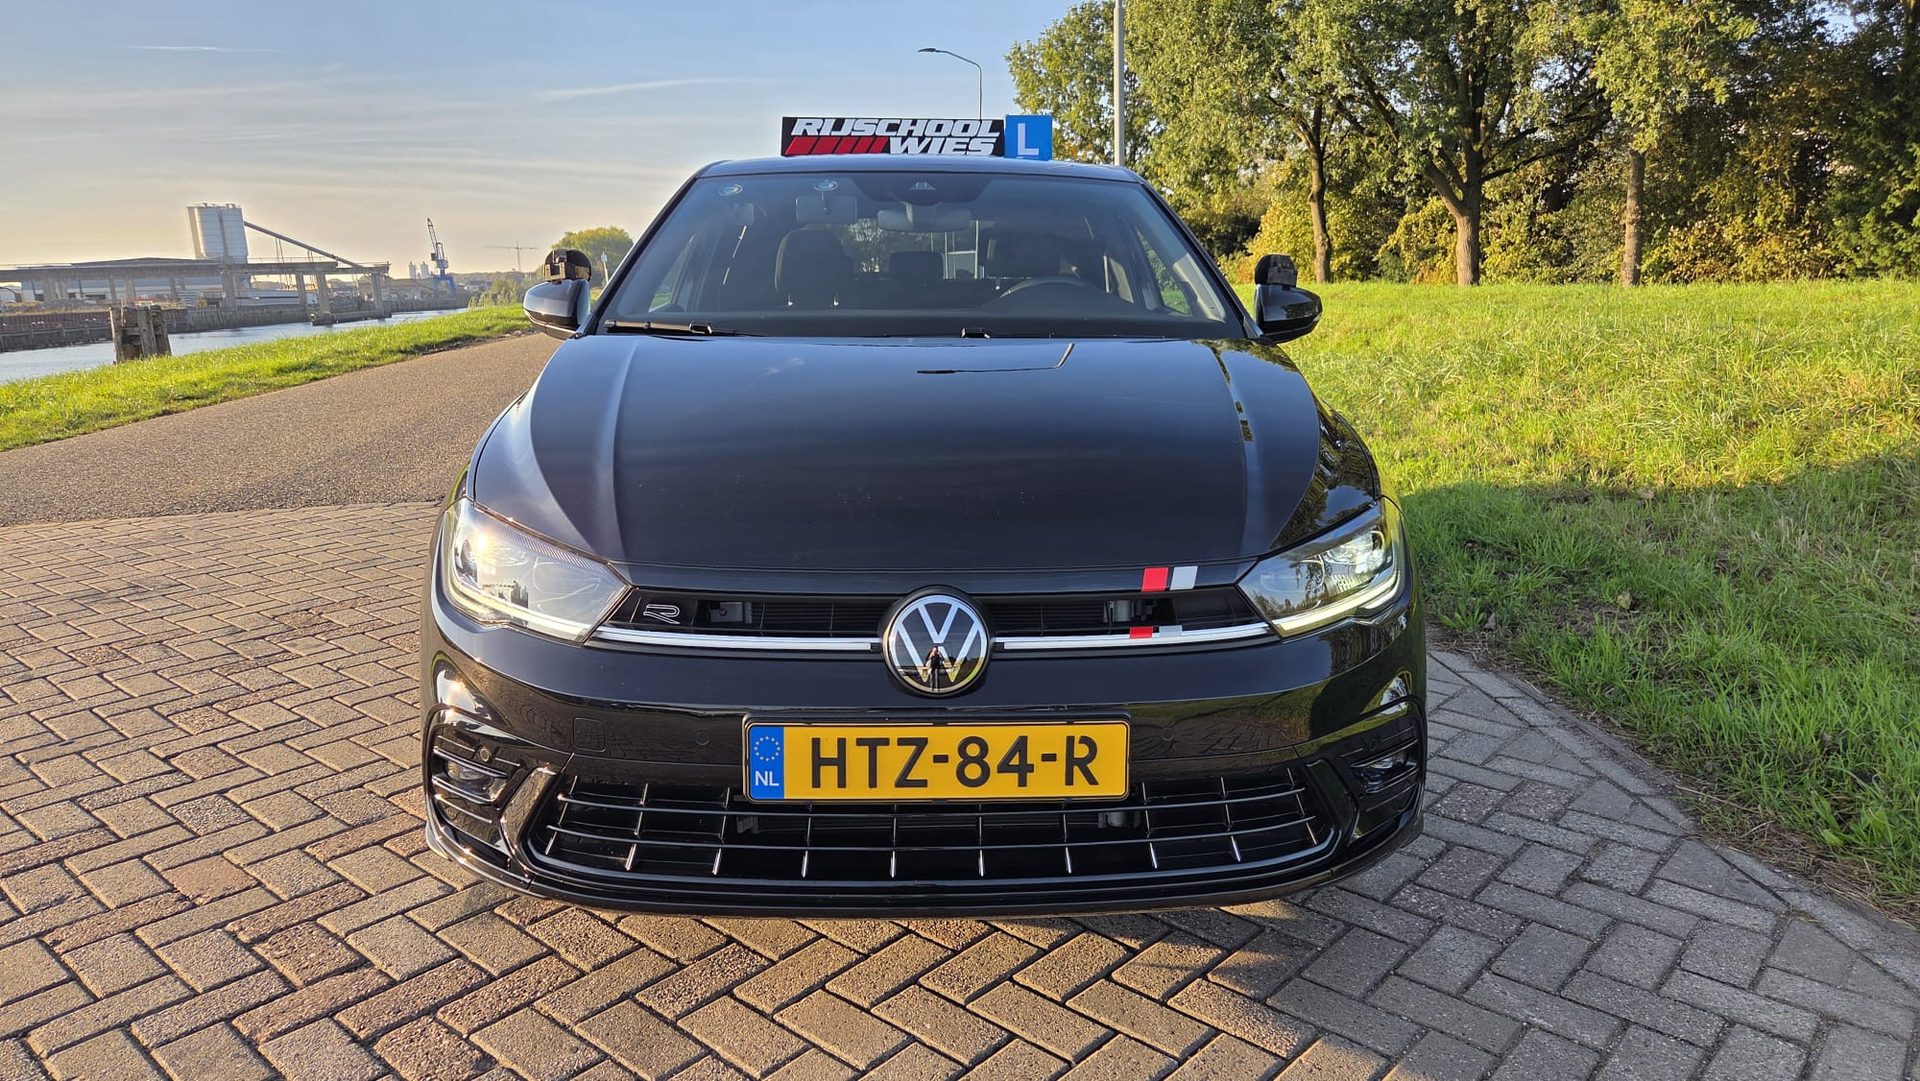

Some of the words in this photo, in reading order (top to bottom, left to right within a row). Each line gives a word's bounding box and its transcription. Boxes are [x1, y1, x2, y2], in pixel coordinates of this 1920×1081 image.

[791, 118, 1000, 137] RIJSCHOOL
[889, 136, 997, 156] WIES
[1017, 122, 1040, 156] L
[643, 602, 680, 625] R
[810, 735, 1099, 788] HTZ-84-R
[754, 770, 780, 787] NL
